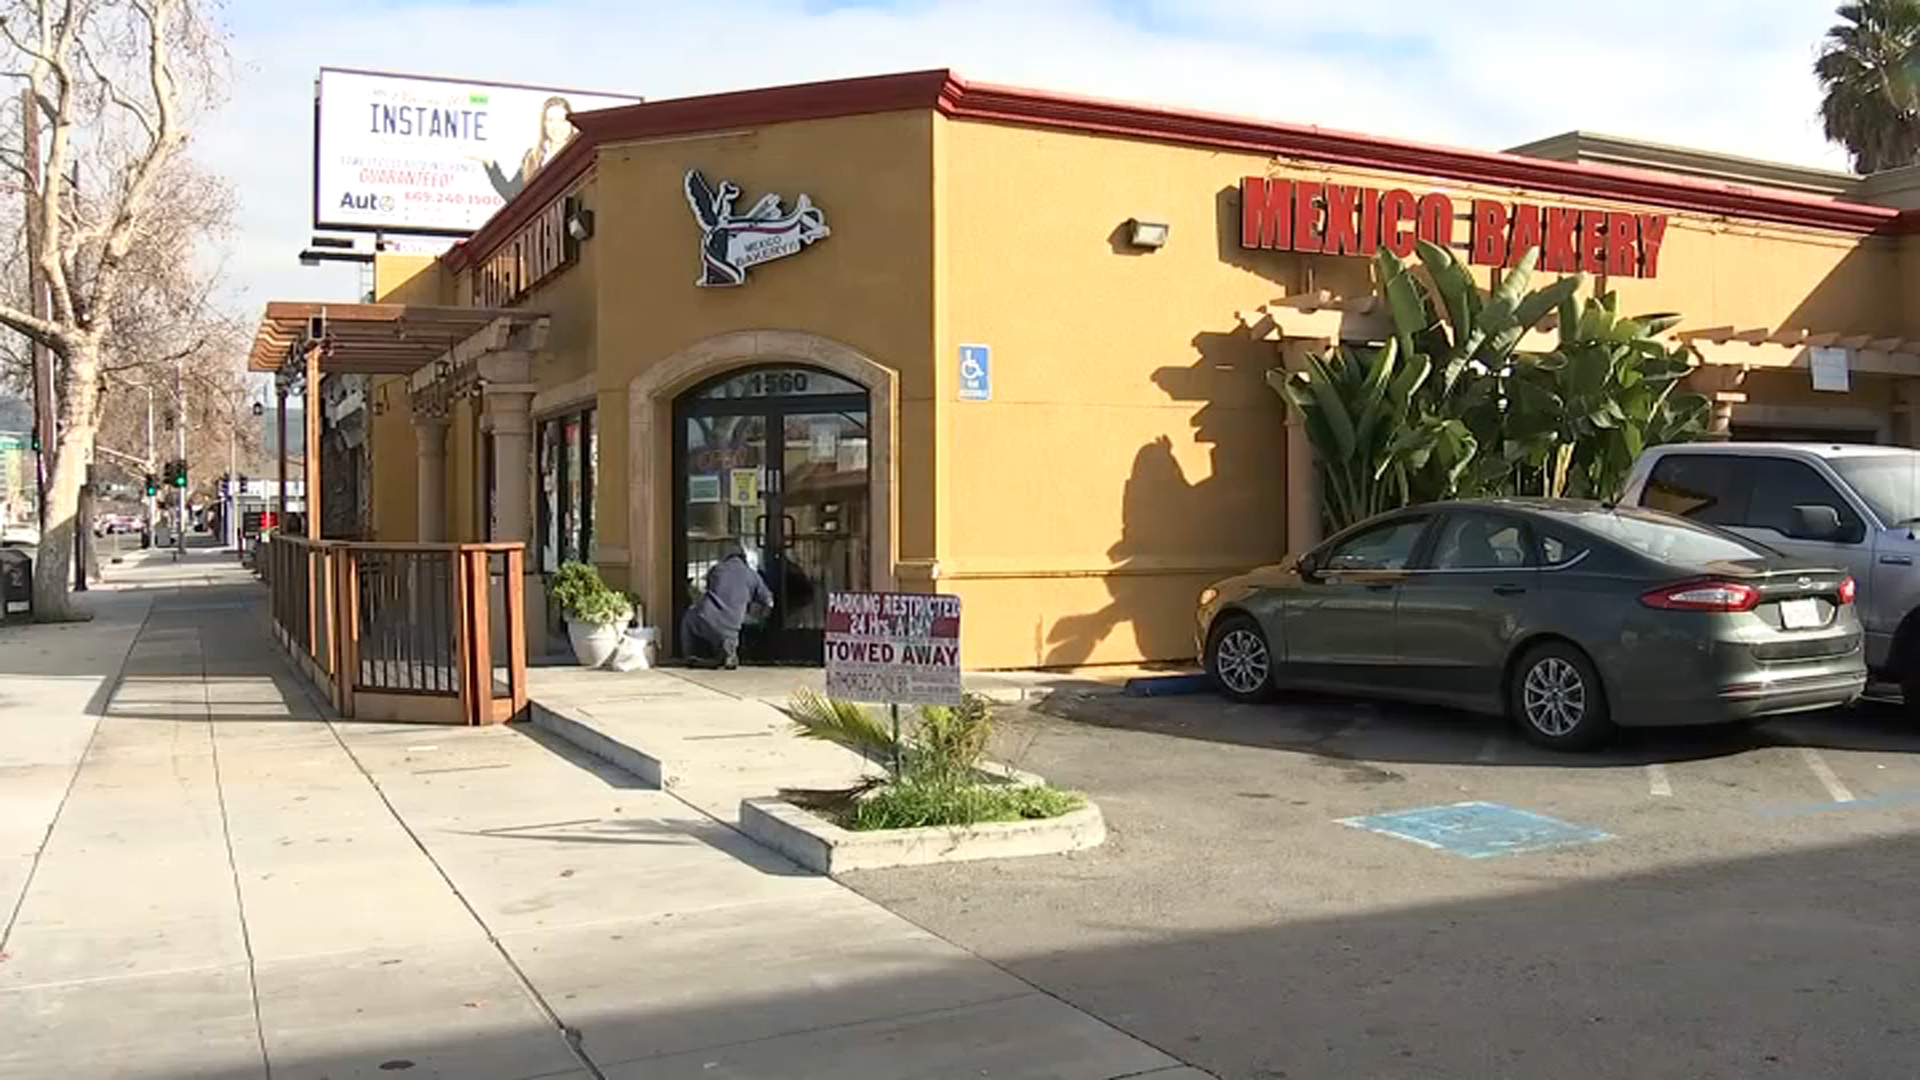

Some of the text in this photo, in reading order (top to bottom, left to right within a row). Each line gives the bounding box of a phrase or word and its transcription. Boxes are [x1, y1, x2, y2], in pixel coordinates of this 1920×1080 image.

[370, 103, 489, 141] INSTANTE
[1240, 176, 1668, 279] MEXICO BAKERY
[736, 243, 789, 266] BAKERY
[744, 235, 782, 251] MEXICO
[751, 373, 808, 393] 1560
[828, 592, 961, 617] PARKING RESTRICTED
[850, 614, 867, 635] 24
[826, 641, 958, 667] TOWED AWAY
